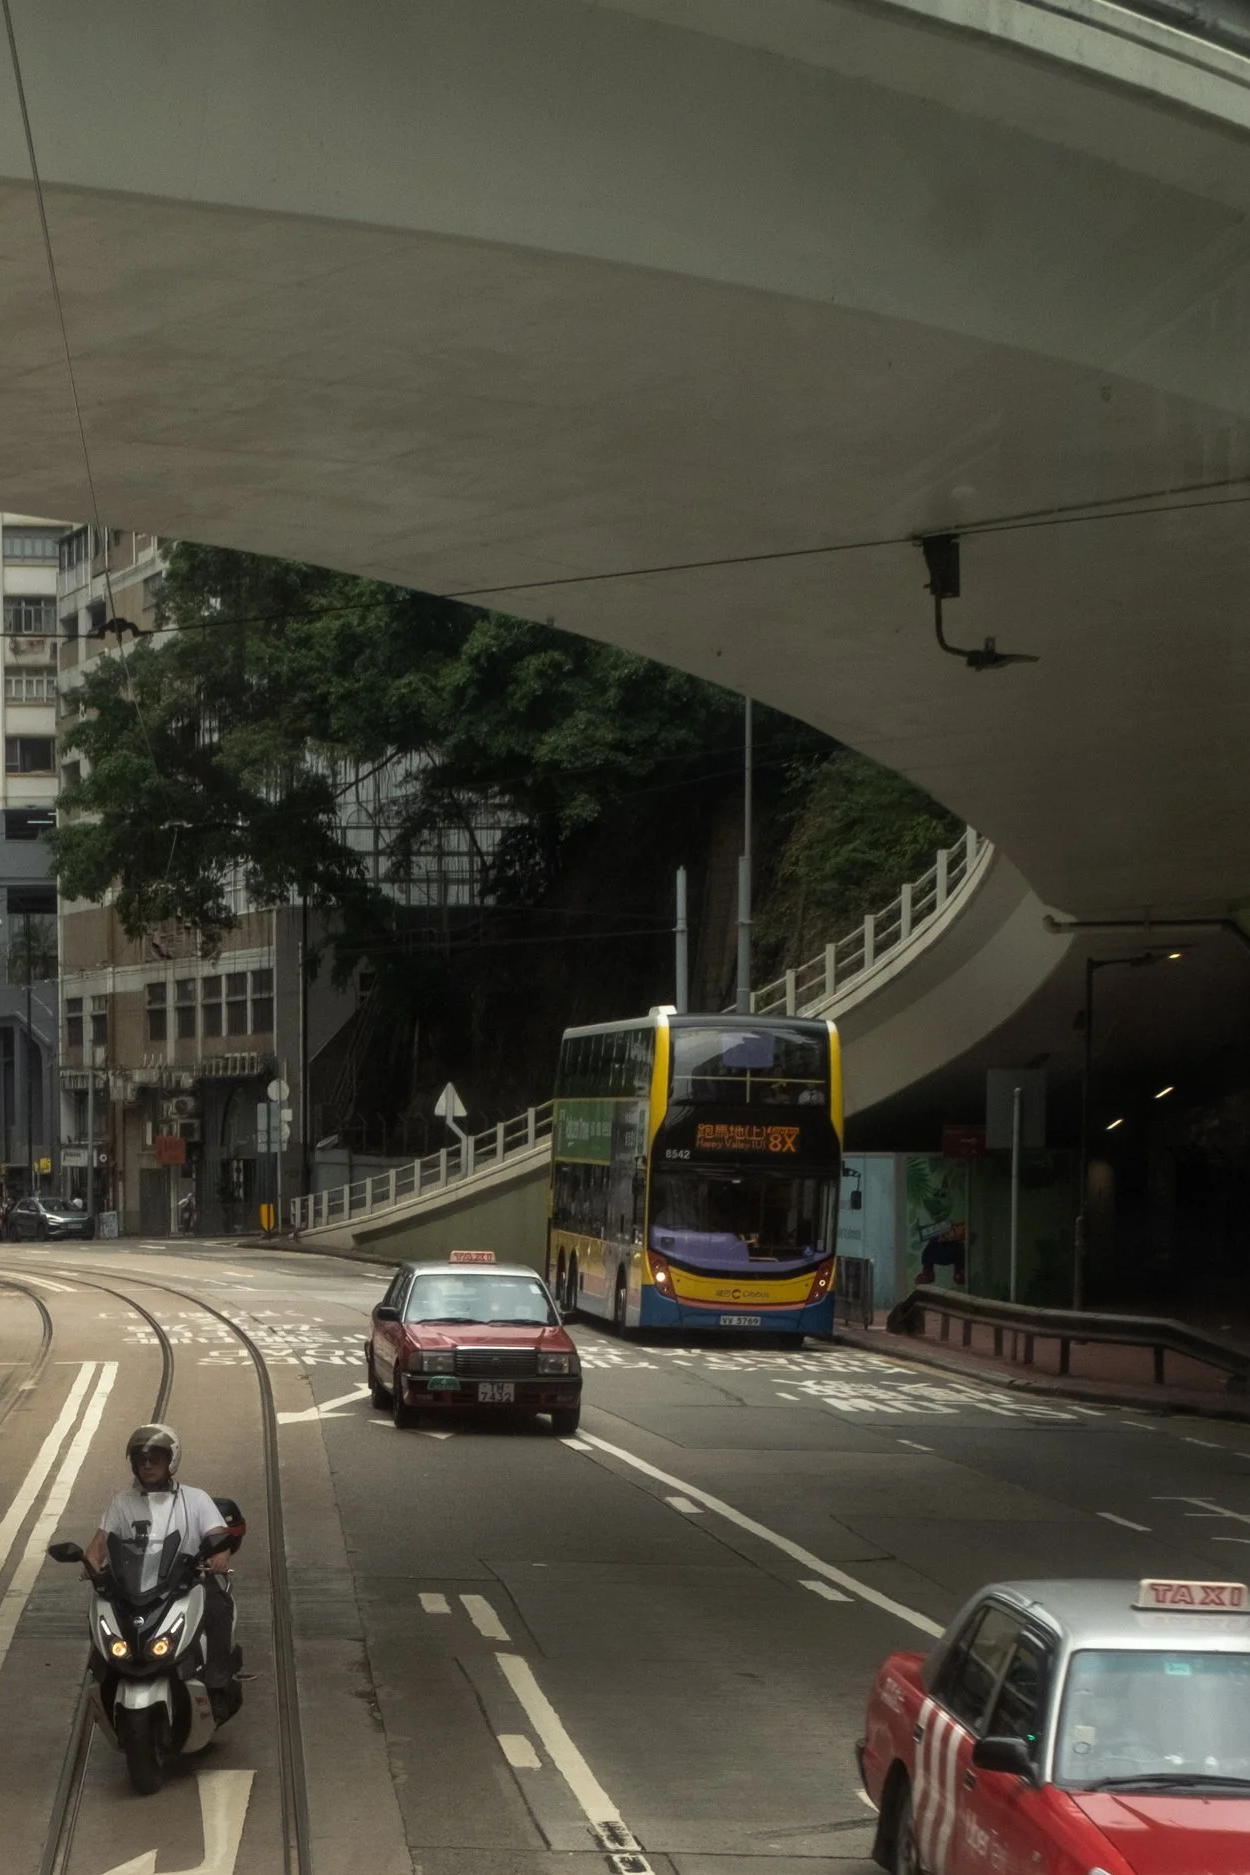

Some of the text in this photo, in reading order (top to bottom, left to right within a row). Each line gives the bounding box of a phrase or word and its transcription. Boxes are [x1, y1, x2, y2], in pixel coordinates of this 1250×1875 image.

[697, 1123, 766, 1141] 跑馬地(上)
[724, 1136, 751, 1150] Valley
[768, 1133, 797, 1153] 8X
[665, 1149, 691, 1160] 8542
[453, 1252, 493, 1262] TAXI
[821, 1397, 1078, 1420] SLOW
[1149, 1583, 1243, 1607] TAXI
